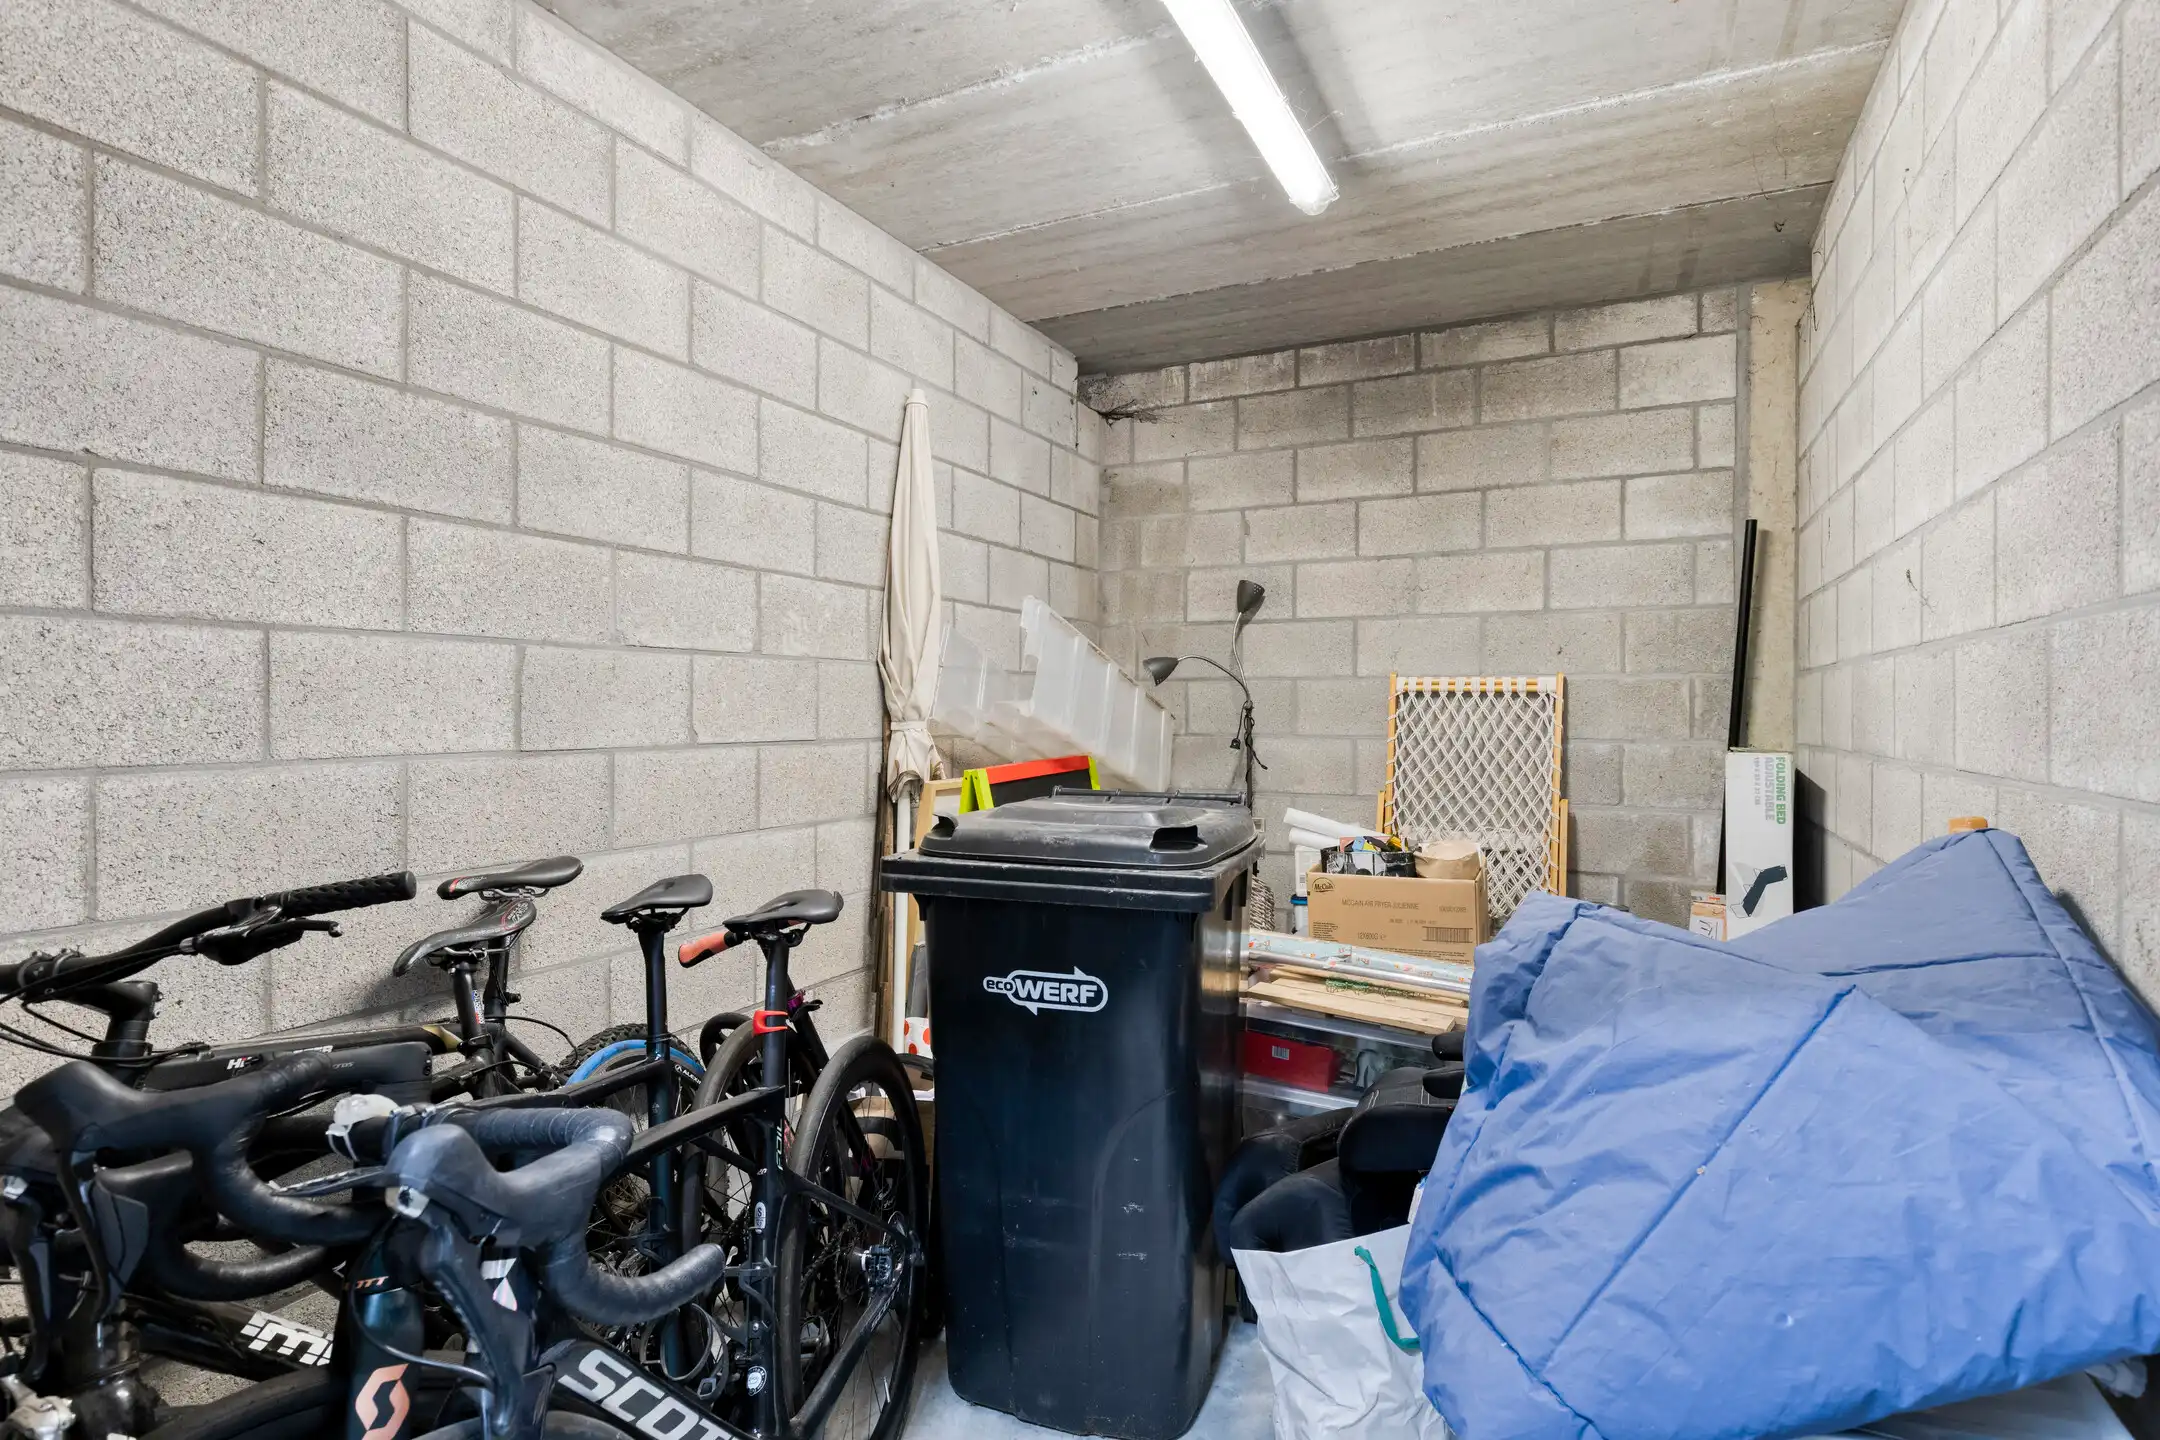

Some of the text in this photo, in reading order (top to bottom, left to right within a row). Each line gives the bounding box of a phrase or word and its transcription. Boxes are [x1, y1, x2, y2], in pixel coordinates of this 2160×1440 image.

[1764, 756, 1775, 821] ADJUSTABLE
[1775, 756, 1786, 825] FOLDING BED
[775, 1118, 784, 1171] FOIL
[558, 1349, 741, 1440] SCOT
